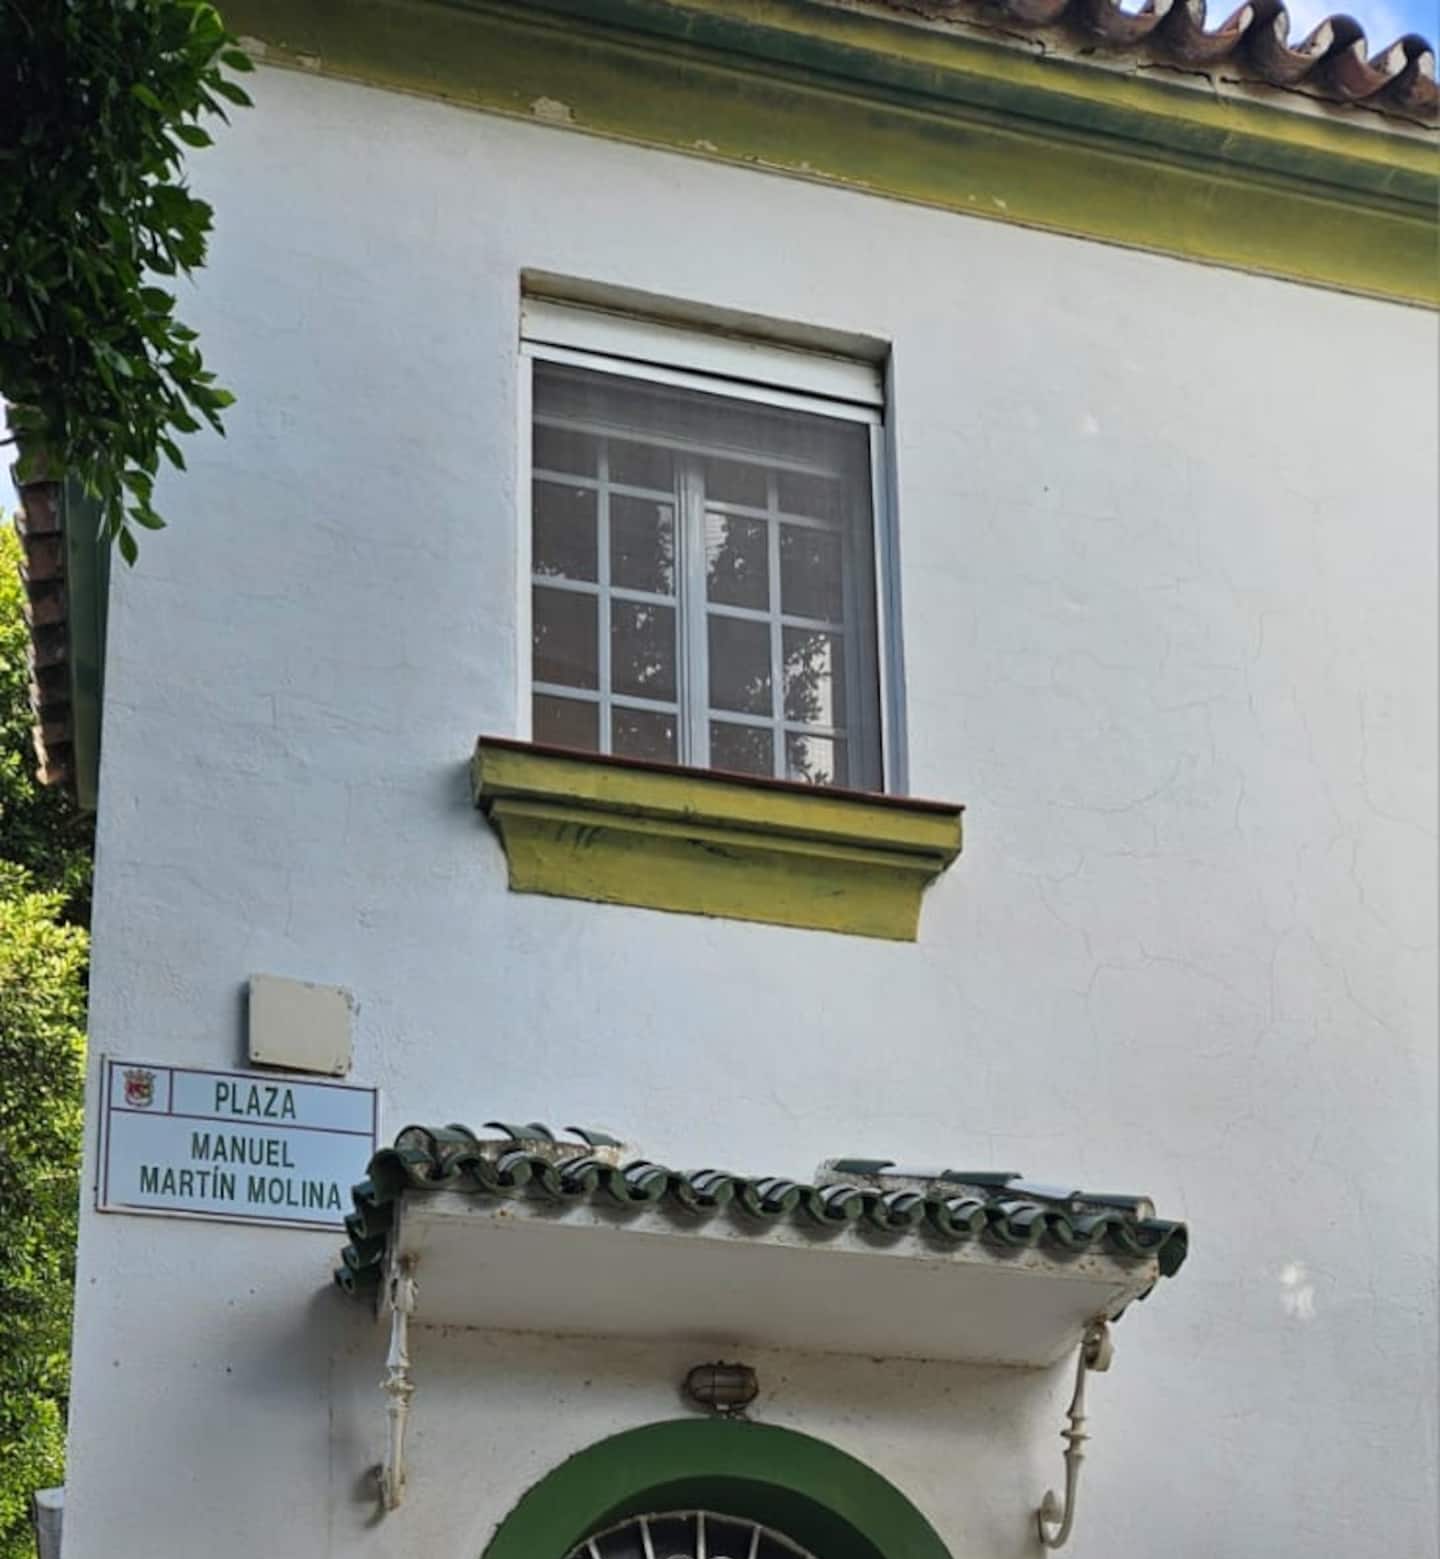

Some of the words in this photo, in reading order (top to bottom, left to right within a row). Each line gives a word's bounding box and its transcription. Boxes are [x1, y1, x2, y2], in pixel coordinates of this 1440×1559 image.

[214, 1081, 297, 1120] PLAZA
[191, 1131, 296, 1168] MANUEL
[140, 1165, 236, 1201] MARTÍN
[247, 1176, 342, 1210] MOLINA
